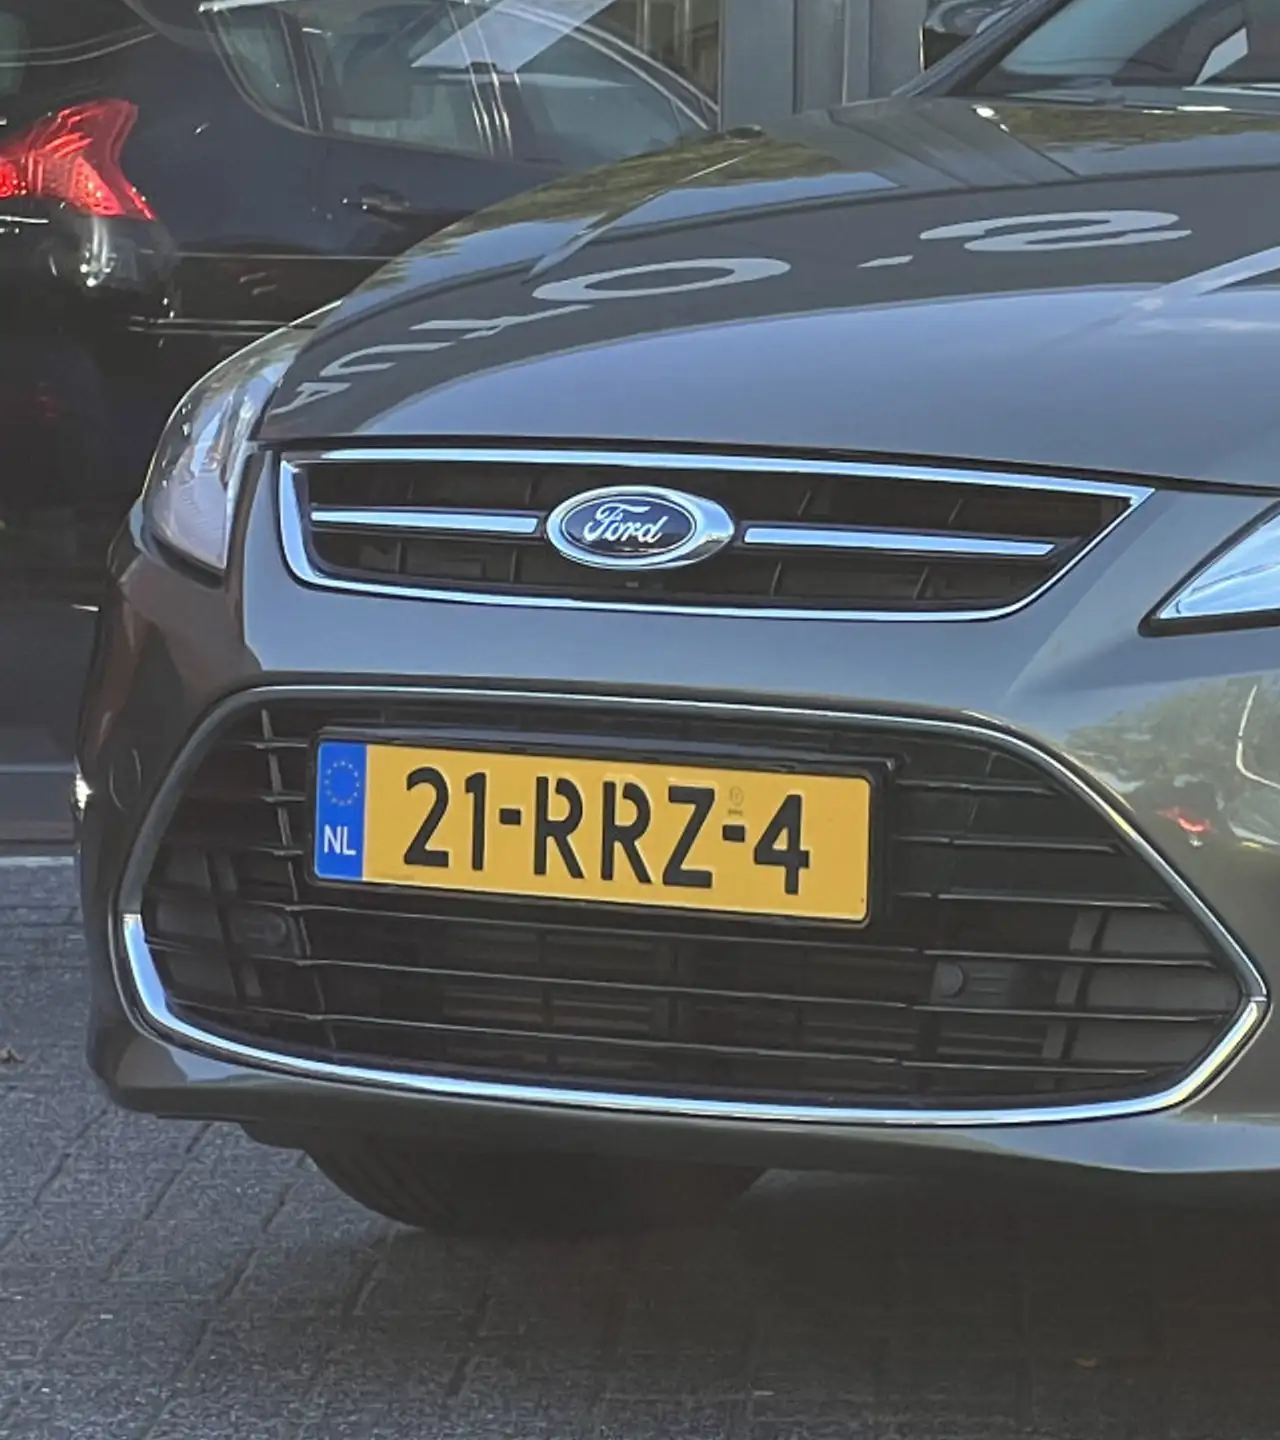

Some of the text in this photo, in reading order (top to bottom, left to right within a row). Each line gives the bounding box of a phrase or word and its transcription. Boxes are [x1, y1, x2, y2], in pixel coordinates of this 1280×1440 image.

[582, 502, 669, 544] Ford
[323, 766, 811, 896] NL 21-RRZ-4
